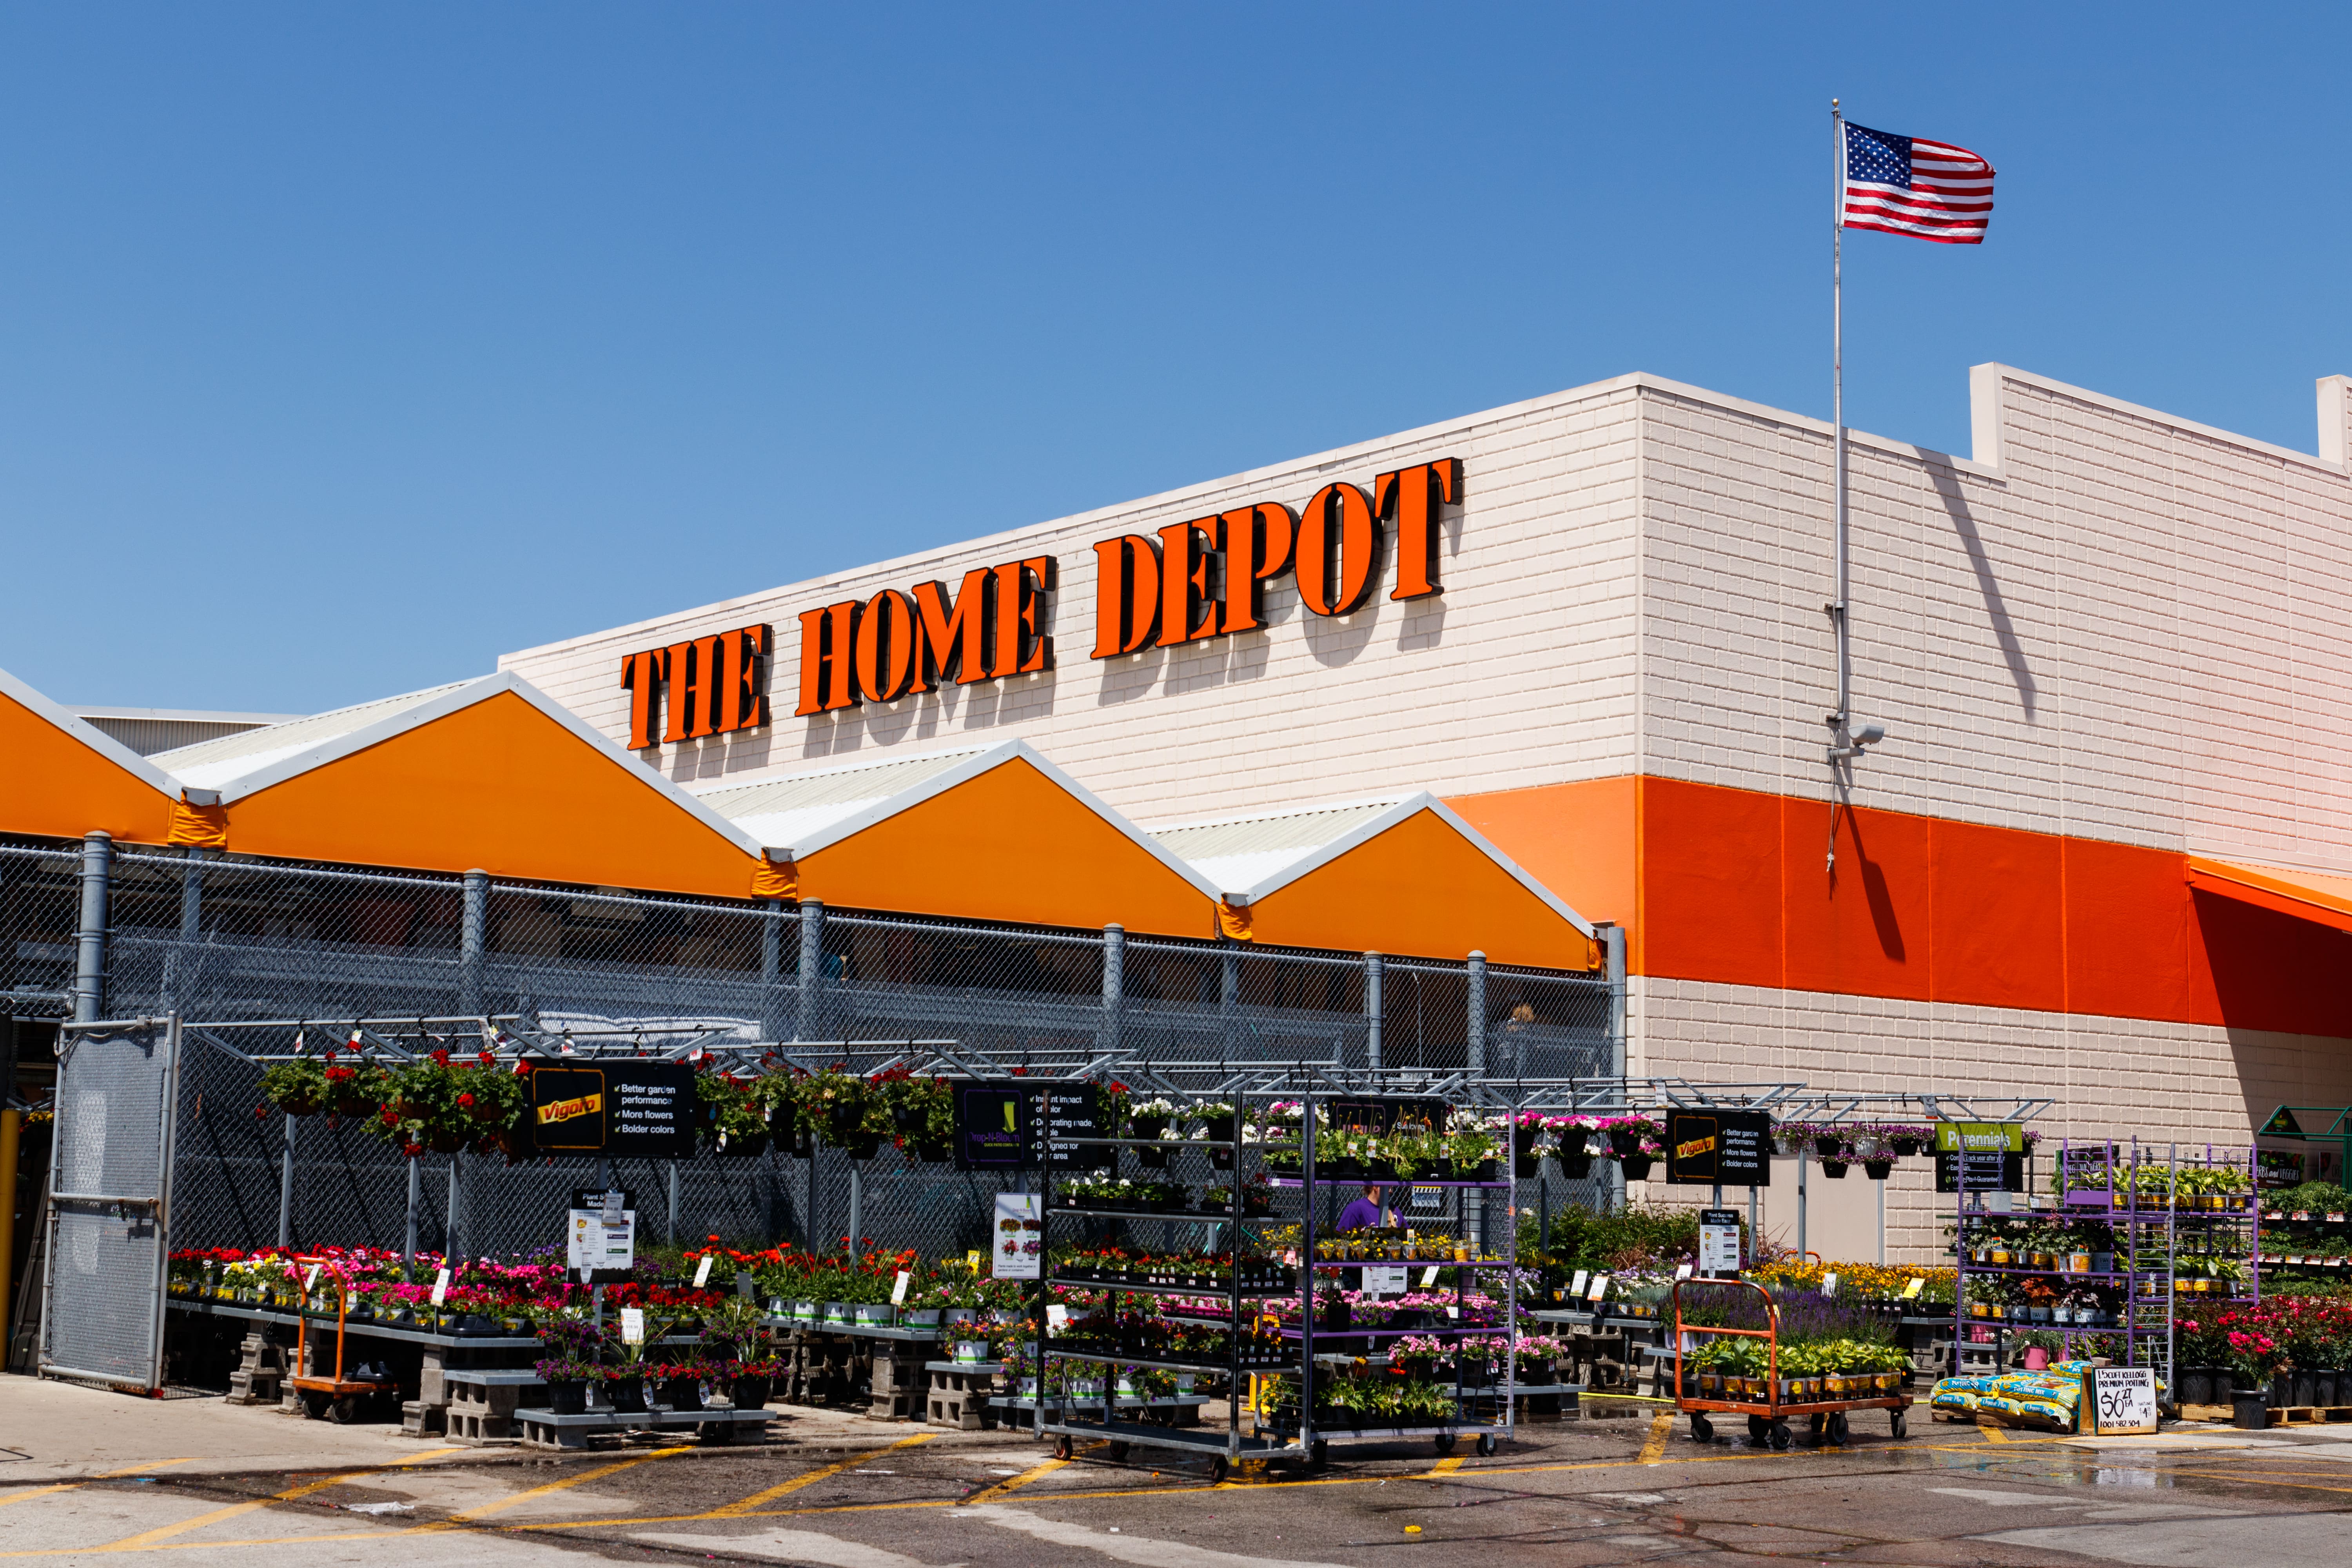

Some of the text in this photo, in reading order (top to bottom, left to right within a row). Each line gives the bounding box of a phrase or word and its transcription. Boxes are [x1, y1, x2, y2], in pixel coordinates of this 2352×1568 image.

[621, 458, 1463, 750] THE HOME DEPOT
[622, 1084, 675, 1095] Better garden
[622, 1095, 672, 1105] performance
[1060, 1096, 1082, 1104] impact
[544, 1100, 595, 1120] Vigoro
[622, 1110, 673, 1119] More flowers
[1036, 1118, 1072, 1128] Dorating
[622, 1124, 675, 1133] Bolder colors
[969, 1132, 1020, 1144] Drop-N-Bloom
[1037, 1142, 1067, 1151] Digned
[1680, 1140, 1711, 1155] Vigoro
[2256, 1165, 2299, 1181] ERBS and VEGGIES
[2098, 1379, 2149, 1388] PREMIUM POTTING
